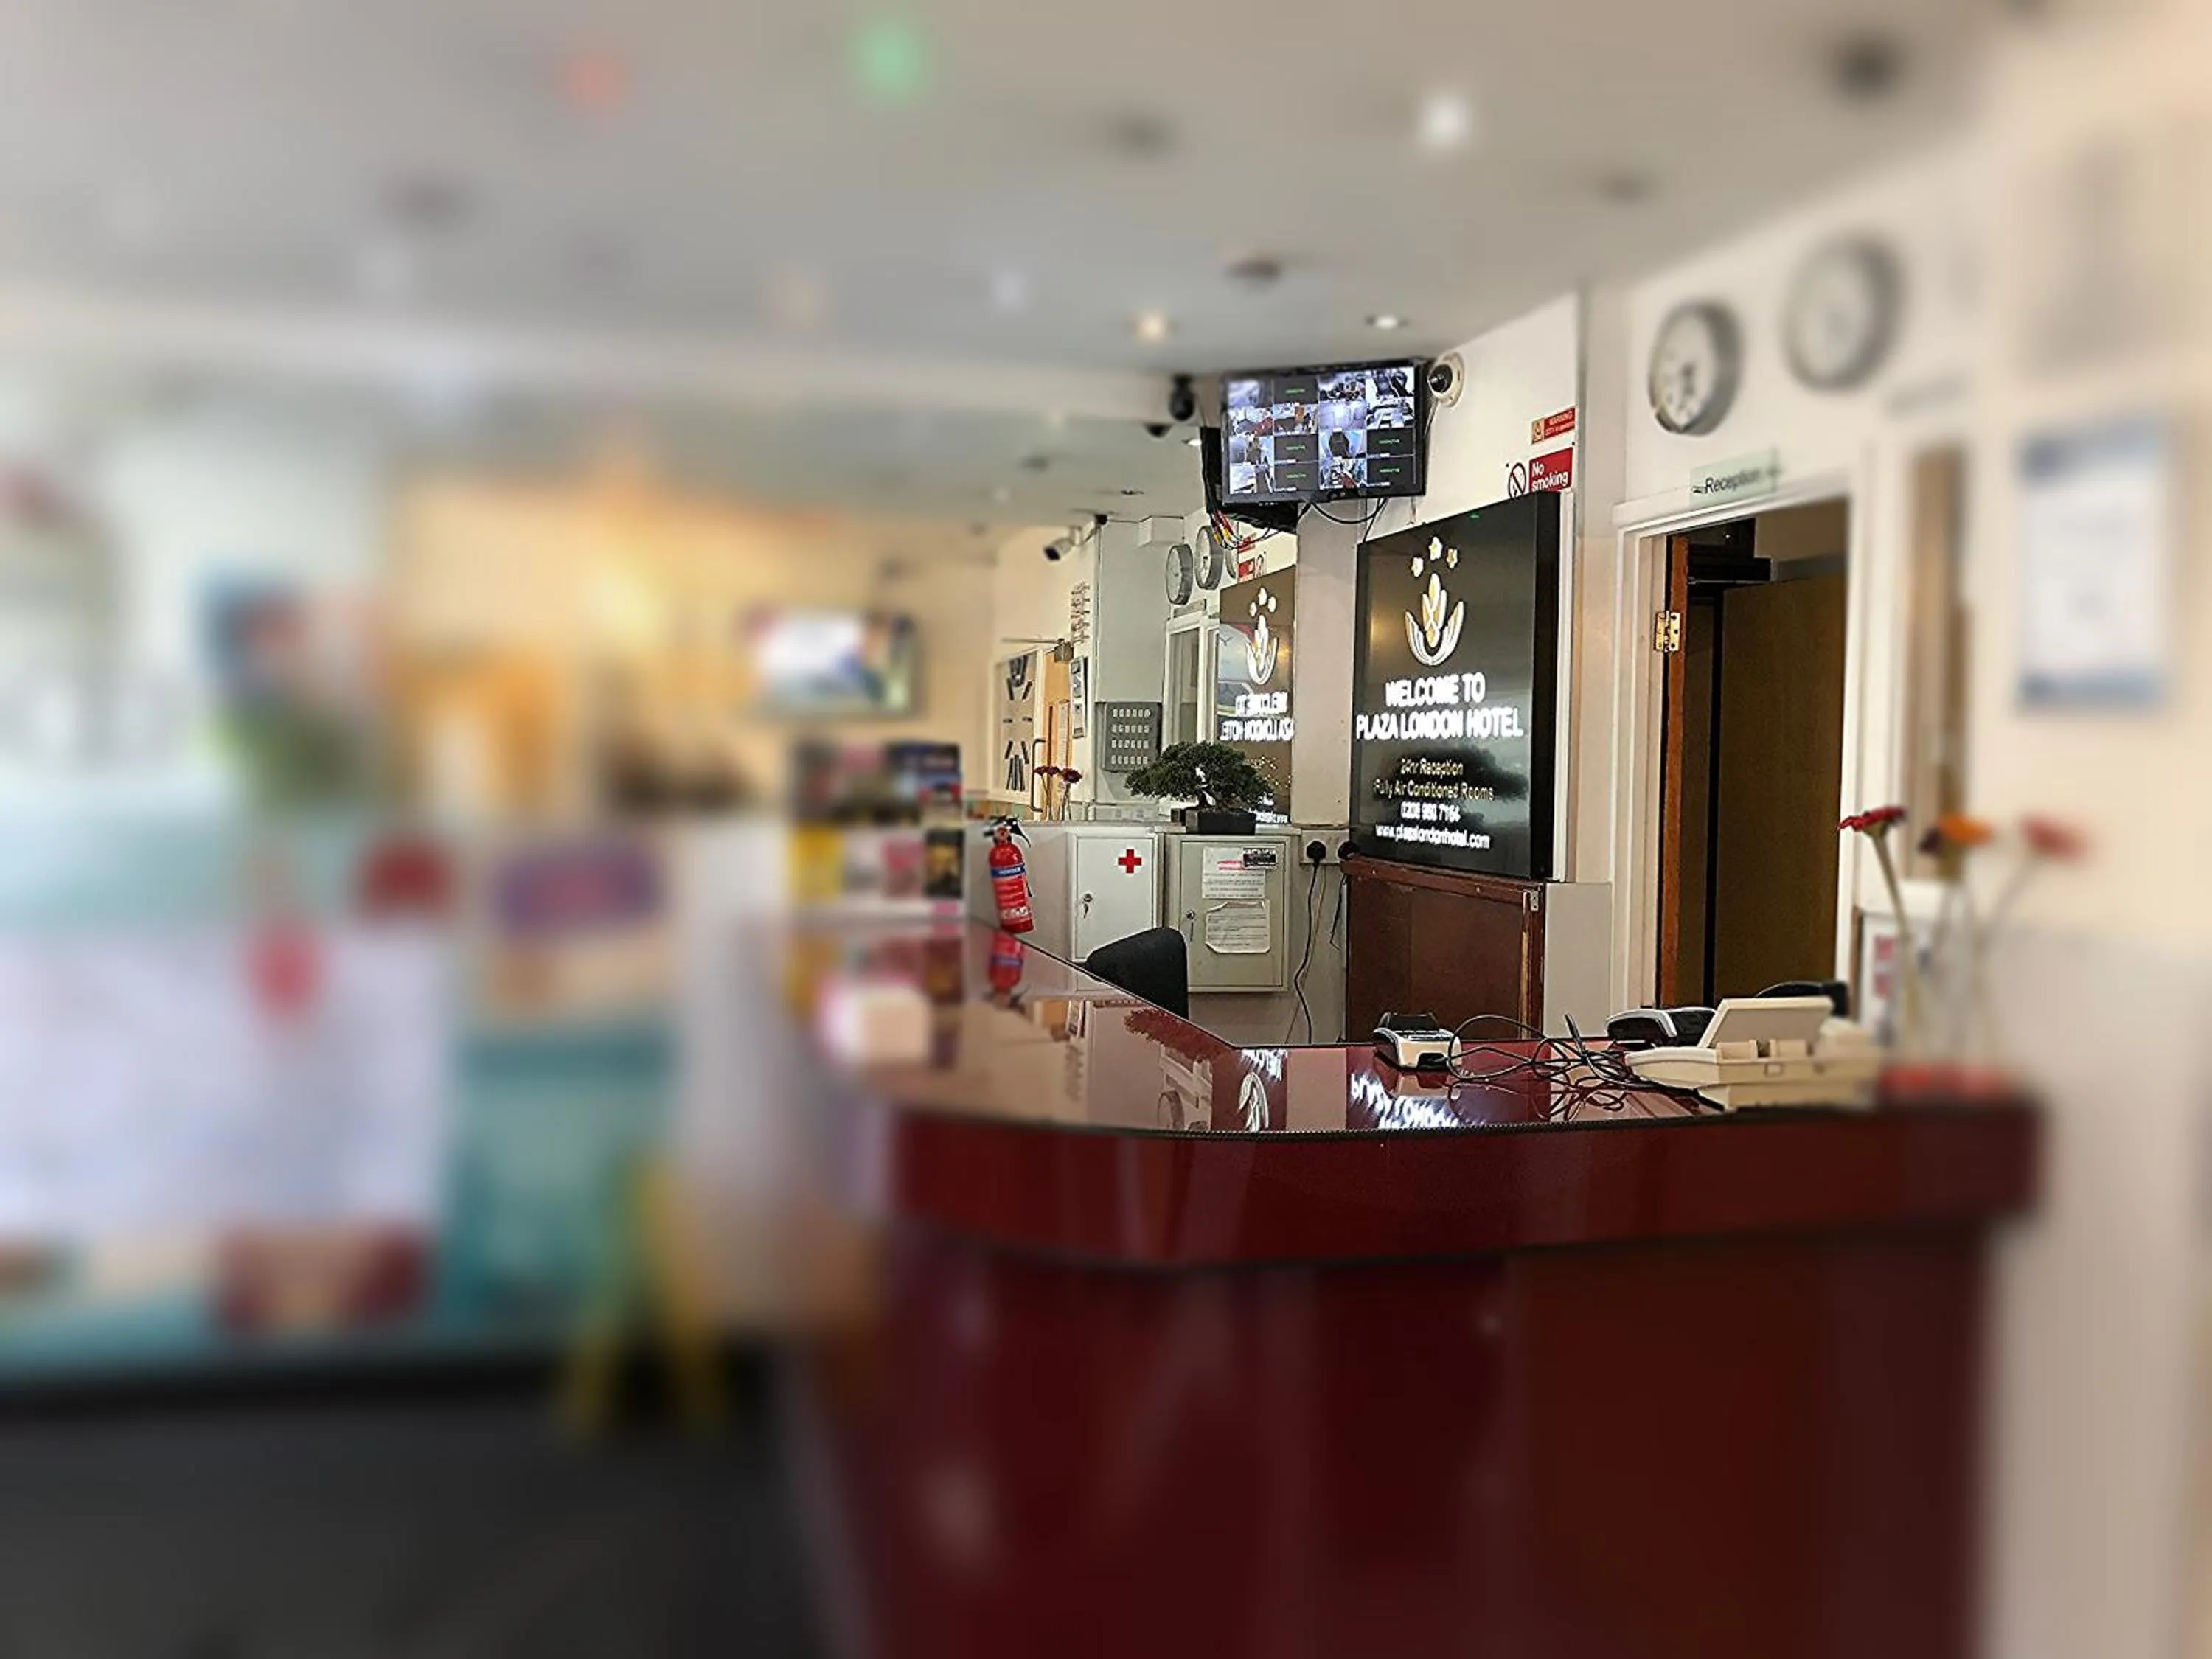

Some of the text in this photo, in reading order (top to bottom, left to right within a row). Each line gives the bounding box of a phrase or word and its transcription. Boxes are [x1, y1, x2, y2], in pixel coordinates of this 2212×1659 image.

[1531, 461, 1545, 477] No
[1531, 470, 1568, 491] smoking
[1705, 470, 1760, 494] Reception
[1385, 672, 1486, 707] WELCOME TO
[1356, 707, 1524, 740] PLAZA LONDON HOTEL
[1419, 757, 1464, 779] Reception
[1374, 778, 1495, 801] Fully Air Conditioned Rooms
